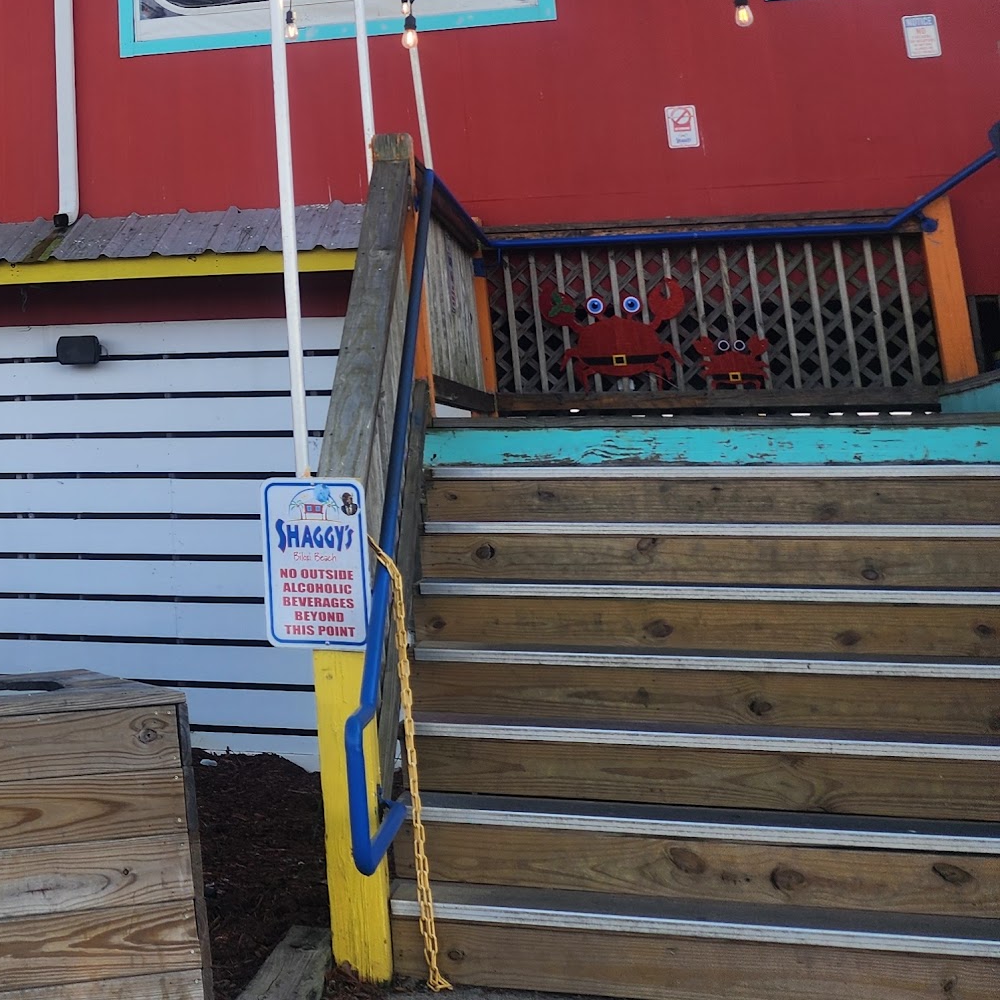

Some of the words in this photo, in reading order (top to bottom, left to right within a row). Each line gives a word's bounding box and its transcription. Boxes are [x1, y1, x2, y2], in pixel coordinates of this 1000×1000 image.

[275, 518, 354, 553] SHAGGY'S
[314, 552, 337, 562] Beach
[280, 568, 297, 579] NO
[300, 569, 354, 581] OUTSIDE
[283, 582, 352, 595] ALCOHOLIC
[282, 596, 355, 609] BEVERAGES
[294, 611, 344, 622] BEYOND
[284, 625, 315, 636] THIS
[318, 625, 356, 637] POINT
